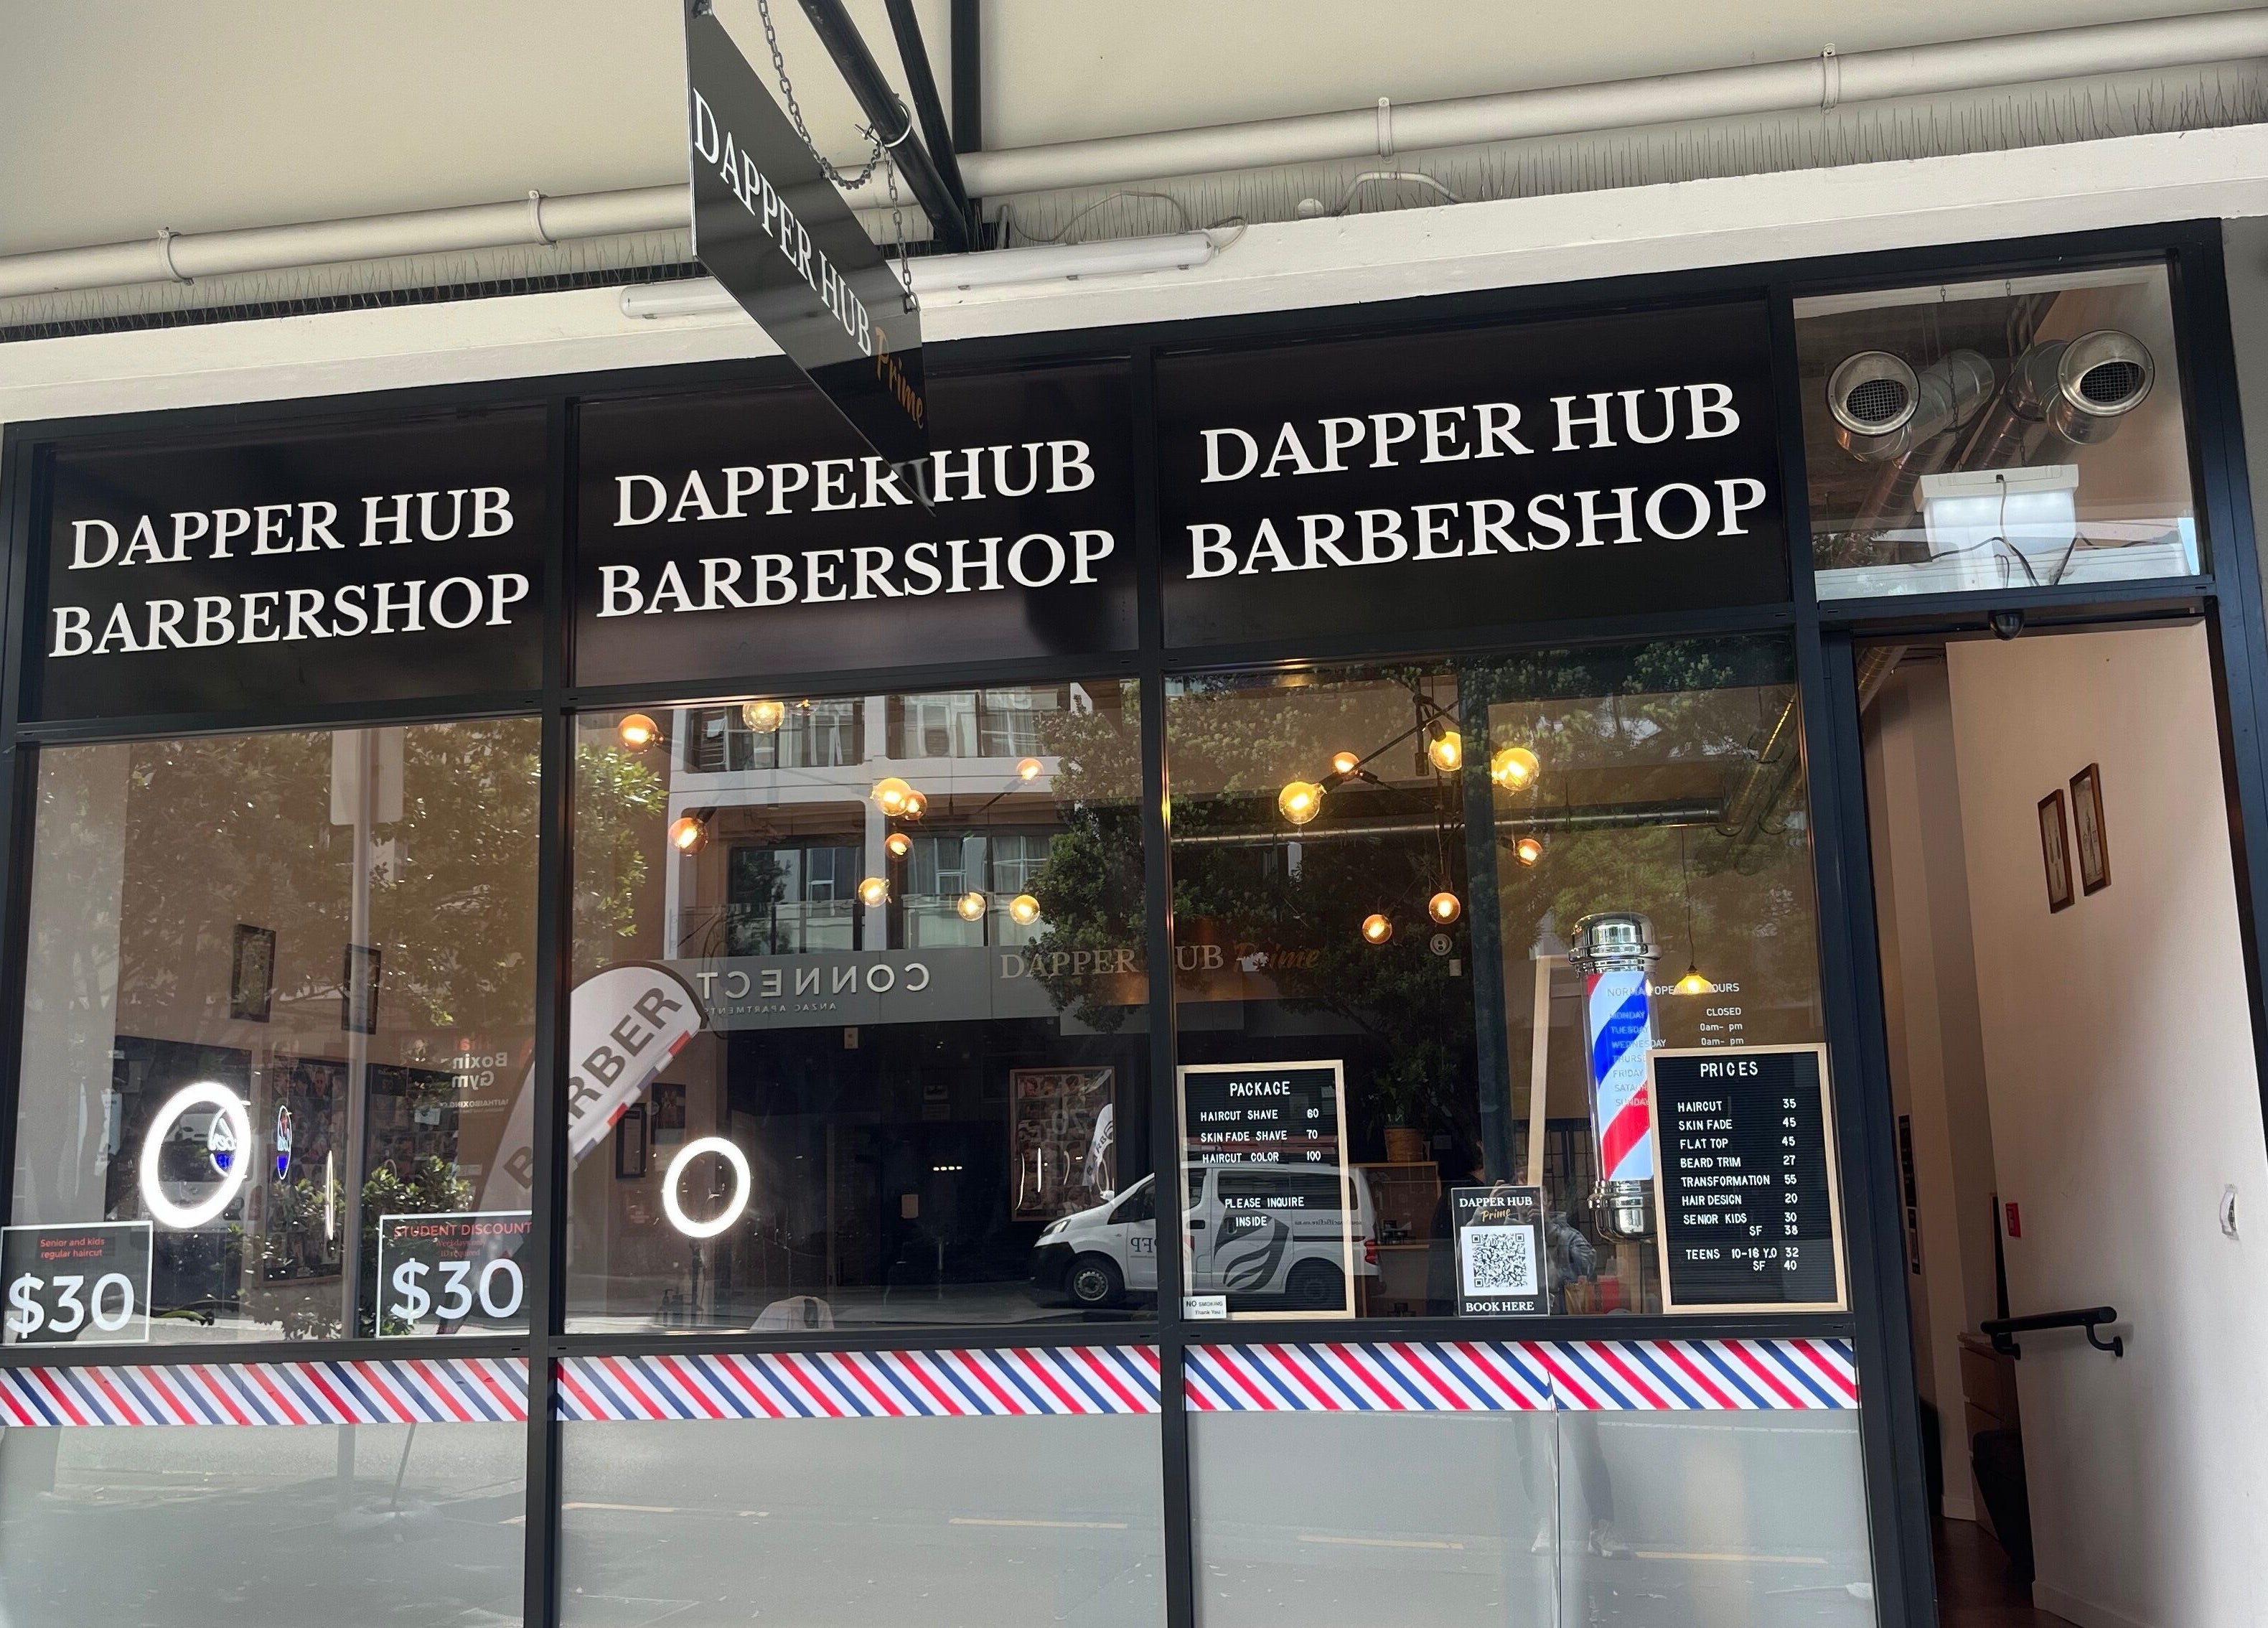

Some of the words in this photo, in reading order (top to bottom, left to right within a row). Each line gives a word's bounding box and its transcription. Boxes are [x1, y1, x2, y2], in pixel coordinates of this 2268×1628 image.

[693, 88, 817, 291] DAPPER
[819, 249, 873, 357] HUB
[875, 325, 924, 430] Prime
[1200, 402, 1534, 483] DAPPER
[1550, 383, 1740, 452] HUB
[614, 456, 913, 527] DAPPER
[930, 439, 1095, 502] HUB
[68, 501, 345, 569] DAPPER
[360, 486, 514, 546] HUB
[1186, 477, 1766, 579] BARBERSHOP
[596, 529, 1115, 617] BARBERSHOP
[49, 574, 530, 658] BARBERSHOP
[1000, 948, 1140, 978] DAPPER
[1175, 944, 1224, 970] UB
[1706, 1007, 1741, 1016] CLOSED
[1611, 1025, 1649, 1034] TUESDAY
[1729, 1024, 1743, 1032] pm
[1611, 1039, 1666, 1048] WEDNESDAY
[1730, 1037, 1744, 1046] pm
[1613, 1069, 1644, 1077] FRIDAY
[1700, 1062, 1758, 1077] PRICES
[1229, 1081, 1290, 1097] PACKAGE
[1678, 1101, 1723, 1113] HAIRCUT
[1782, 1098, 1796, 1108] 35
[1201, 1110, 1241, 1122] HAIRCUT
[1247, 1109, 1278, 1120] SHAVE
[1306, 1108, 1319, 1119] 60
[1679, 1121, 1704, 1131] SKIN
[1707, 1119, 1733, 1130] FADE
[1782, 1117, 1796, 1128] 45
[1200, 1132, 1223, 1143] SKIN
[1225, 1131, 1250, 1142] FADE
[1256, 1130, 1288, 1141] SHAVE
[1306, 1129, 1318, 1140] 70
[1680, 1138, 1707, 1149] FLAT
[1710, 1138, 1728, 1149] TOP
[1781, 1136, 1796, 1146] 45
[1202, 1153, 1242, 1164] HAIRCUT
[1251, 1151, 1279, 1163] COLOR
[1306, 1150, 1321, 1161] 100
[1680, 1158, 1713, 1169] BEARD
[1717, 1157, 1741, 1167] TRIM
[1783, 1155, 1796, 1166] 27
[1681, 1174, 1771, 1187] TRANSFORMATION
[1784, 1174, 1797, 1184] 55
[1224, 1197, 1261, 1209] PLEASE
[1267, 1196, 1305, 1207] INQUIRE
[1459, 1197, 1506, 1207] DAPPER
[1507, 1196, 1533, 1206] HUB
[1682, 1195, 1705, 1206] HAIR
[1707, 1194, 1742, 1205] DESIGN
[1784, 1192, 1798, 1204] 20
[1235, 1216, 1267, 1227] INSIDE
[1481, 1207, 1511, 1222] Prime
[1683, 1214, 1718, 1225] SENIOR
[1725, 1213, 1748, 1224] KIDS
[1784, 1212, 1797, 1222] 30
[393, 1225, 458, 1239] STUDENT
[461, 1222, 533, 1235] DISCOUNT
[1749, 1225, 1763, 1236] SF
[1784, 1225, 1799, 1235] 38
[40, 1239, 67, 1248] Senior
[69, 1238, 85, 1247] and
[88, 1238, 105, 1246] kids
[41, 1250, 70, 1260] regular
[72, 1249, 103, 1258] haircut
[1686, 1249, 1720, 1260] TEENS
[1731, 1248, 1759, 1258] 10-16
[1784, 1247, 1799, 1258] 32
[1753, 1260, 1766, 1271] SF
[1784, 1260, 1797, 1271] 40
[390, 1257, 524, 1325] $30
[6, 1272, 135, 1339] $30
[1466, 1301, 1501, 1312] BOOK
[1502, 1301, 1534, 1311] HERE
